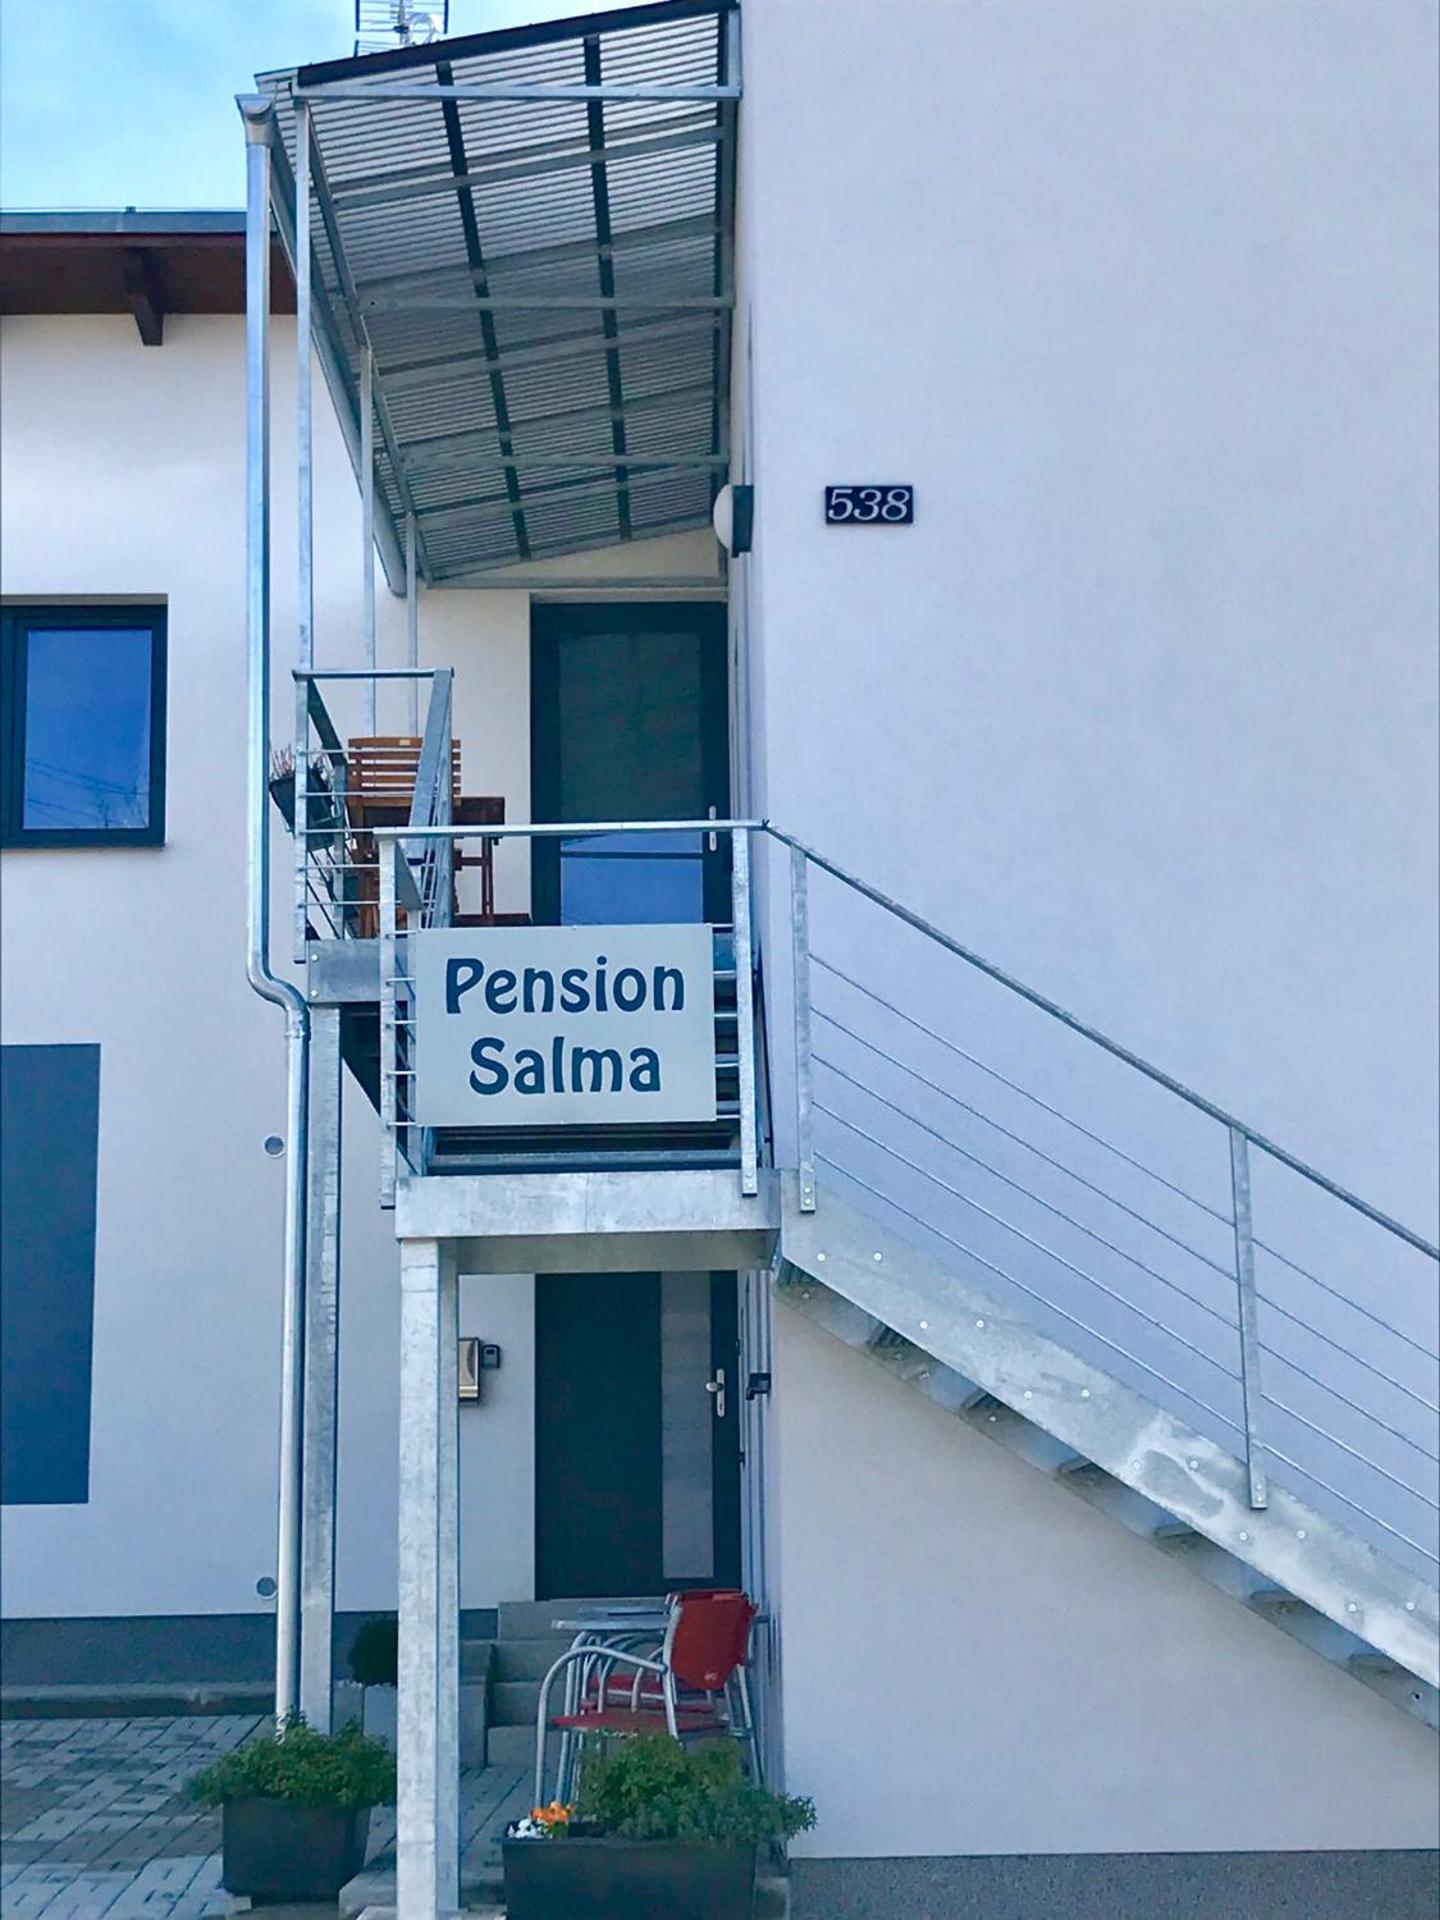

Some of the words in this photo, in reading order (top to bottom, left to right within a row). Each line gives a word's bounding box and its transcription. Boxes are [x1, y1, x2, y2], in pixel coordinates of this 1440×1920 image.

[828, 488, 910, 520] 538
[445, 955, 685, 1014] Pension
[469, 1036, 661, 1095] Salma
